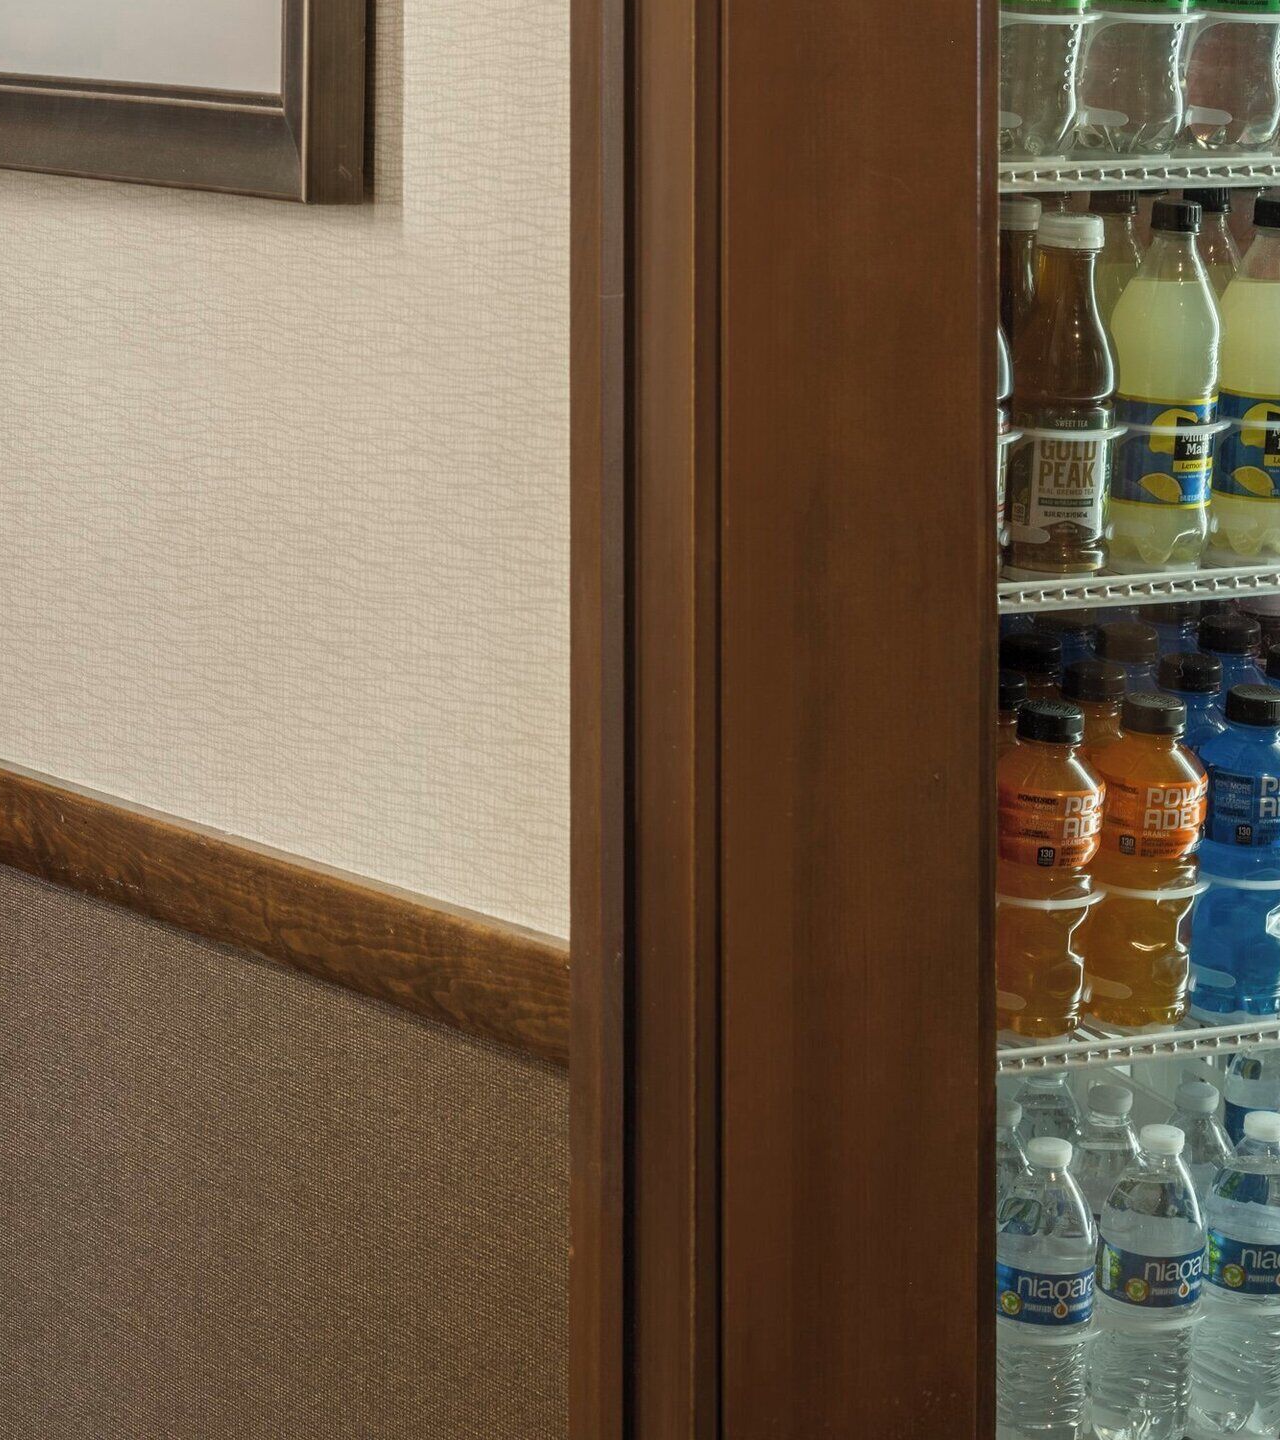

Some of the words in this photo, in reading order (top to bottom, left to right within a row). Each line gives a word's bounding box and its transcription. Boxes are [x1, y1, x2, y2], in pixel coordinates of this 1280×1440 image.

[1055, 419, 1075, 428] SWEET
[1077, 420, 1089, 428] TEA
[1038, 461, 1095, 488] PEAK
[1230, 782, 1252, 790] MORE
[1143, 808, 1190, 829] ADE
[1143, 830, 1170, 838] ORANGE
[1238, 827, 1251, 837] 130
[1120, 836, 1134, 847] 130
[1040, 849, 1054, 858] 130
